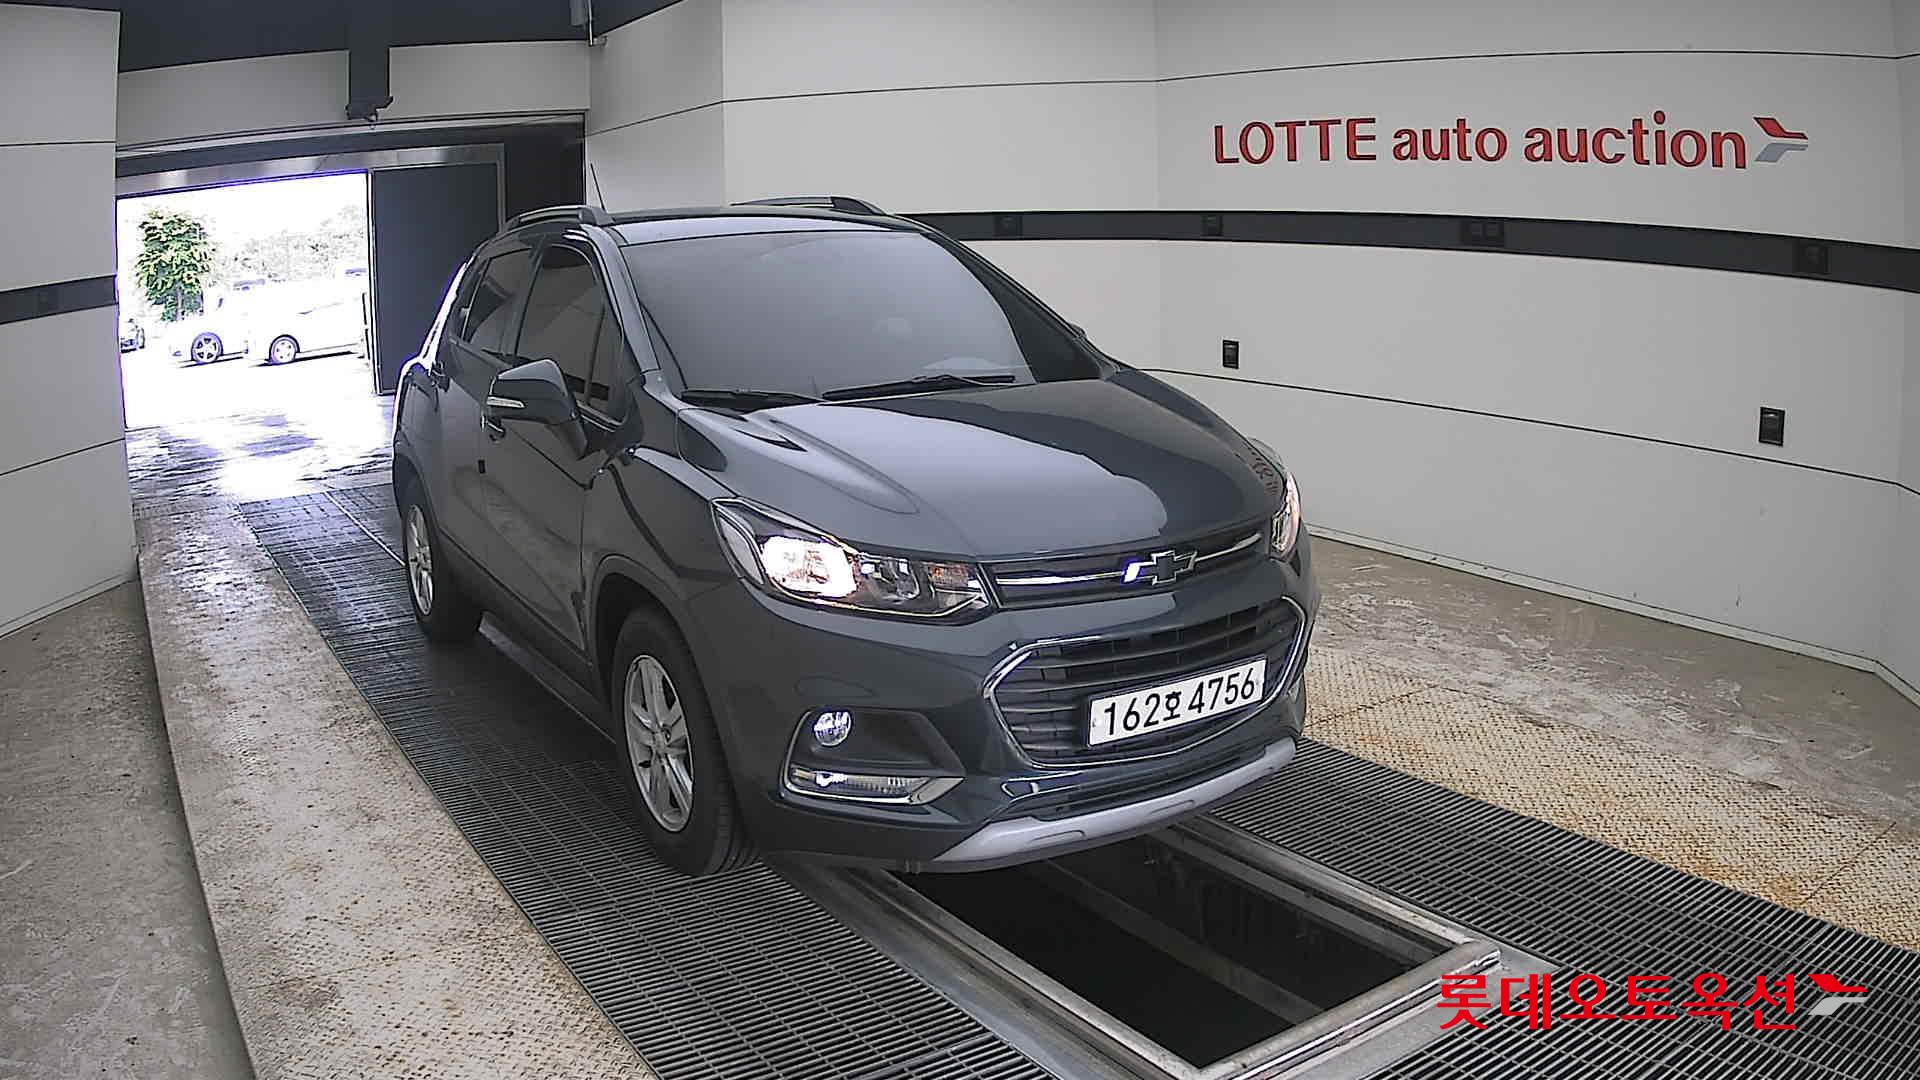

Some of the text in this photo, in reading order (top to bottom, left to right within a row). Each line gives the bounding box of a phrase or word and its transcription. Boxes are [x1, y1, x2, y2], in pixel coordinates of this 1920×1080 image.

[1214, 110, 1747, 169] LOTTE auto auction
